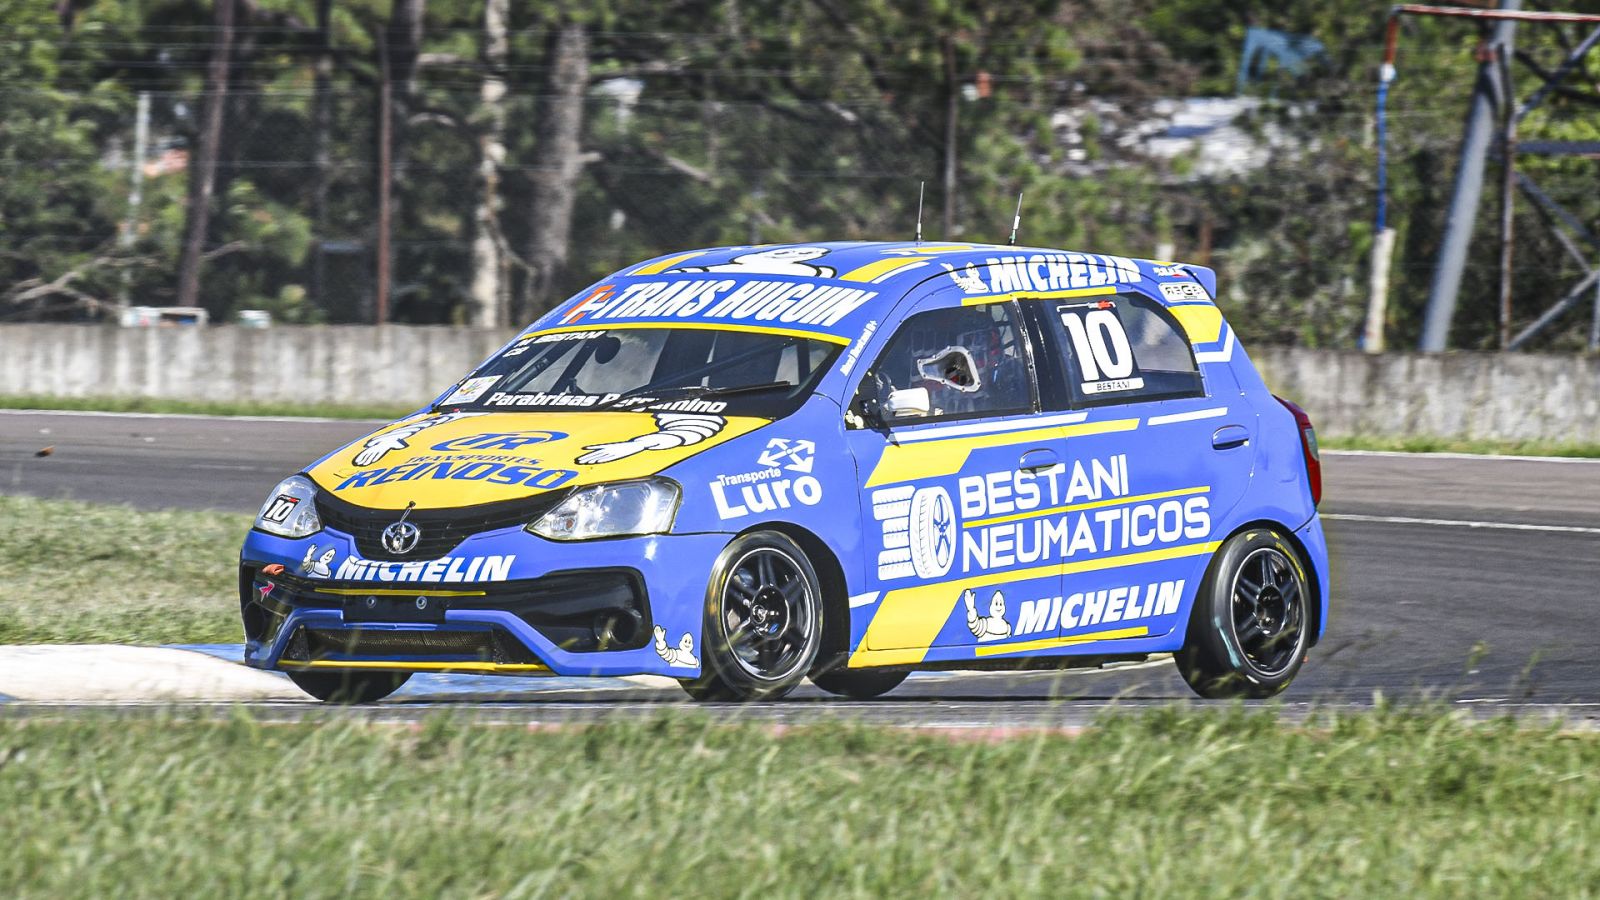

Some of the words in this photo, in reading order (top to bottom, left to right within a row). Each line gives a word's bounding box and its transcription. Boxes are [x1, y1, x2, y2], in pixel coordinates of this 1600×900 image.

[986, 254, 1142, 292] MICHELIN
[591, 279, 737, 319] TRANS
[702, 282, 879, 328] HUGUIN
[1060, 310, 1133, 381] 10
[483, 391, 600, 407] Parabrisas
[1096, 381, 1131, 391] BESTANI
[333, 461, 580, 490] REINOSO
[405, 455, 544, 465] TRANSPORTES
[716, 467, 782, 487] Transporte
[958, 453, 1129, 519] BESTANI
[265, 499, 295, 522] 10
[708, 475, 823, 521] Luro
[962, 496, 1211, 573] NEUMATICOS
[334, 554, 517, 583] MICHELIN
[1013, 579, 1185, 636] MICHELIN
